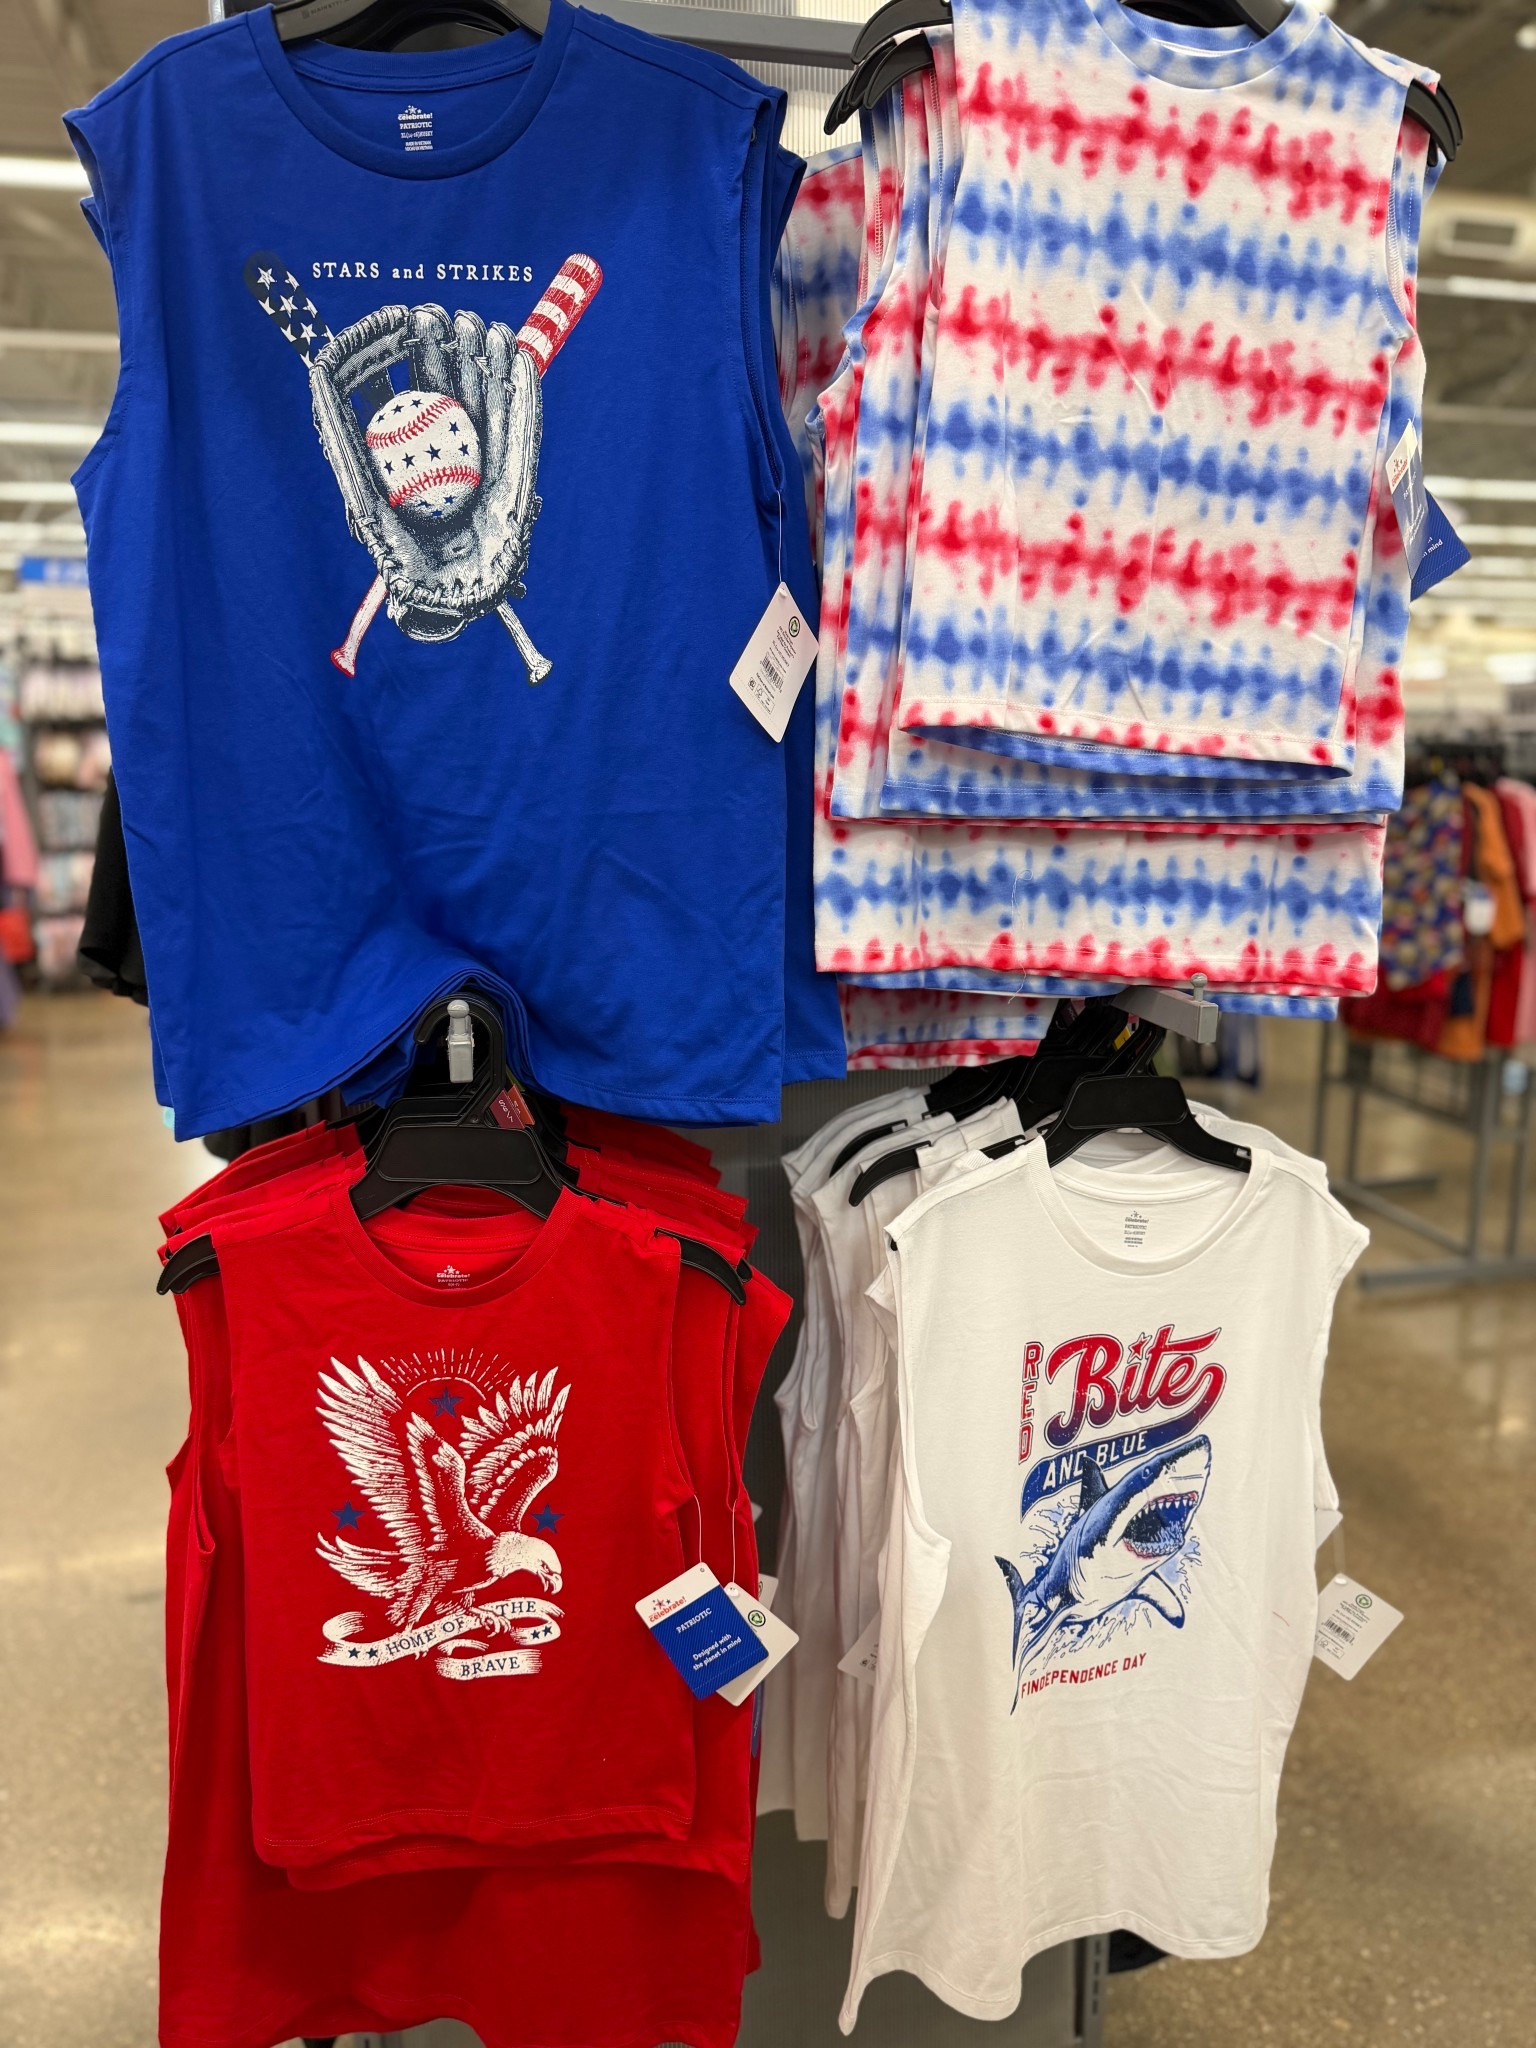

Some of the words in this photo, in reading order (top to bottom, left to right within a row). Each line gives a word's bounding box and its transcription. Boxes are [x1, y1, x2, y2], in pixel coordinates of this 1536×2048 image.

[399, 121, 433, 130] PATRIOTIC
[312, 261, 380, 279] STARS
[392, 263, 425, 279] and
[436, 263, 533, 282] STRIKES
[1427, 539, 1444, 554] mind
[1044, 1324, 1226, 1449] Bite
[1018, 1341, 1044, 1466] RED
[1042, 1450, 1087, 1491] AND
[1096, 1431, 1148, 1465] BLUE
[385, 1628, 437, 1656] HOME
[443, 1616, 466, 1632] OF
[496, 1600, 537, 1617] THE
[676, 1607, 713, 1633] PATRIOTIC
[692, 1641, 719, 1661] Designed
[718, 1633, 732, 1645] with
[693, 1661, 704, 1671] the
[703, 1652, 722, 1666] planet
[727, 1636, 742, 1649] mind
[460, 1656, 521, 1677] BRAVE
[1021, 1660, 1118, 1699] FINDEPENDENCE
[1122, 1652, 1147, 1671] DAY
